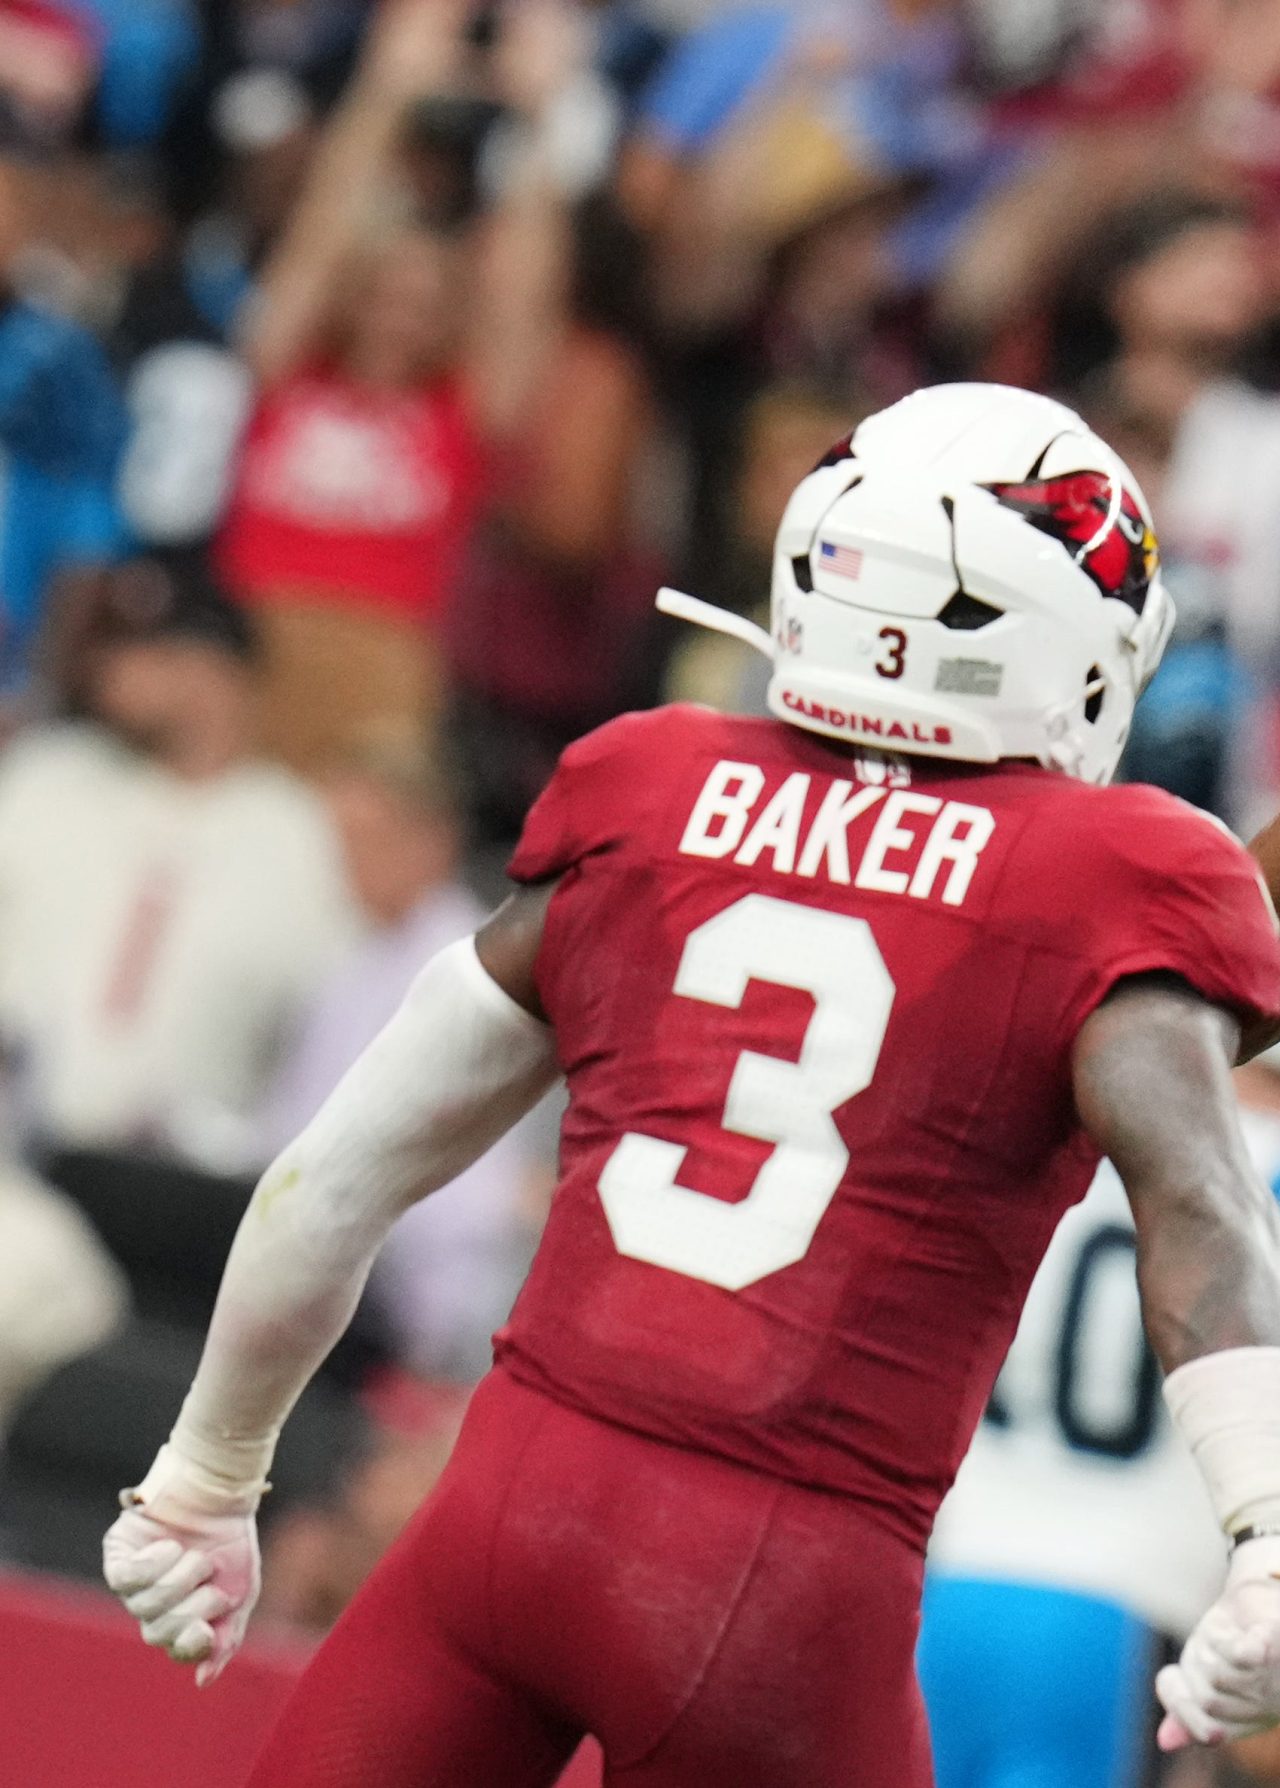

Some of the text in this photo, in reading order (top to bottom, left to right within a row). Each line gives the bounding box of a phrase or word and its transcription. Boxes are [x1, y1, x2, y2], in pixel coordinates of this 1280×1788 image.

[875, 625, 907, 680] 3
[782, 690, 953, 745] CARDINALS
[678, 759, 996, 907] BAKER
[597, 892, 897, 1292] 3
